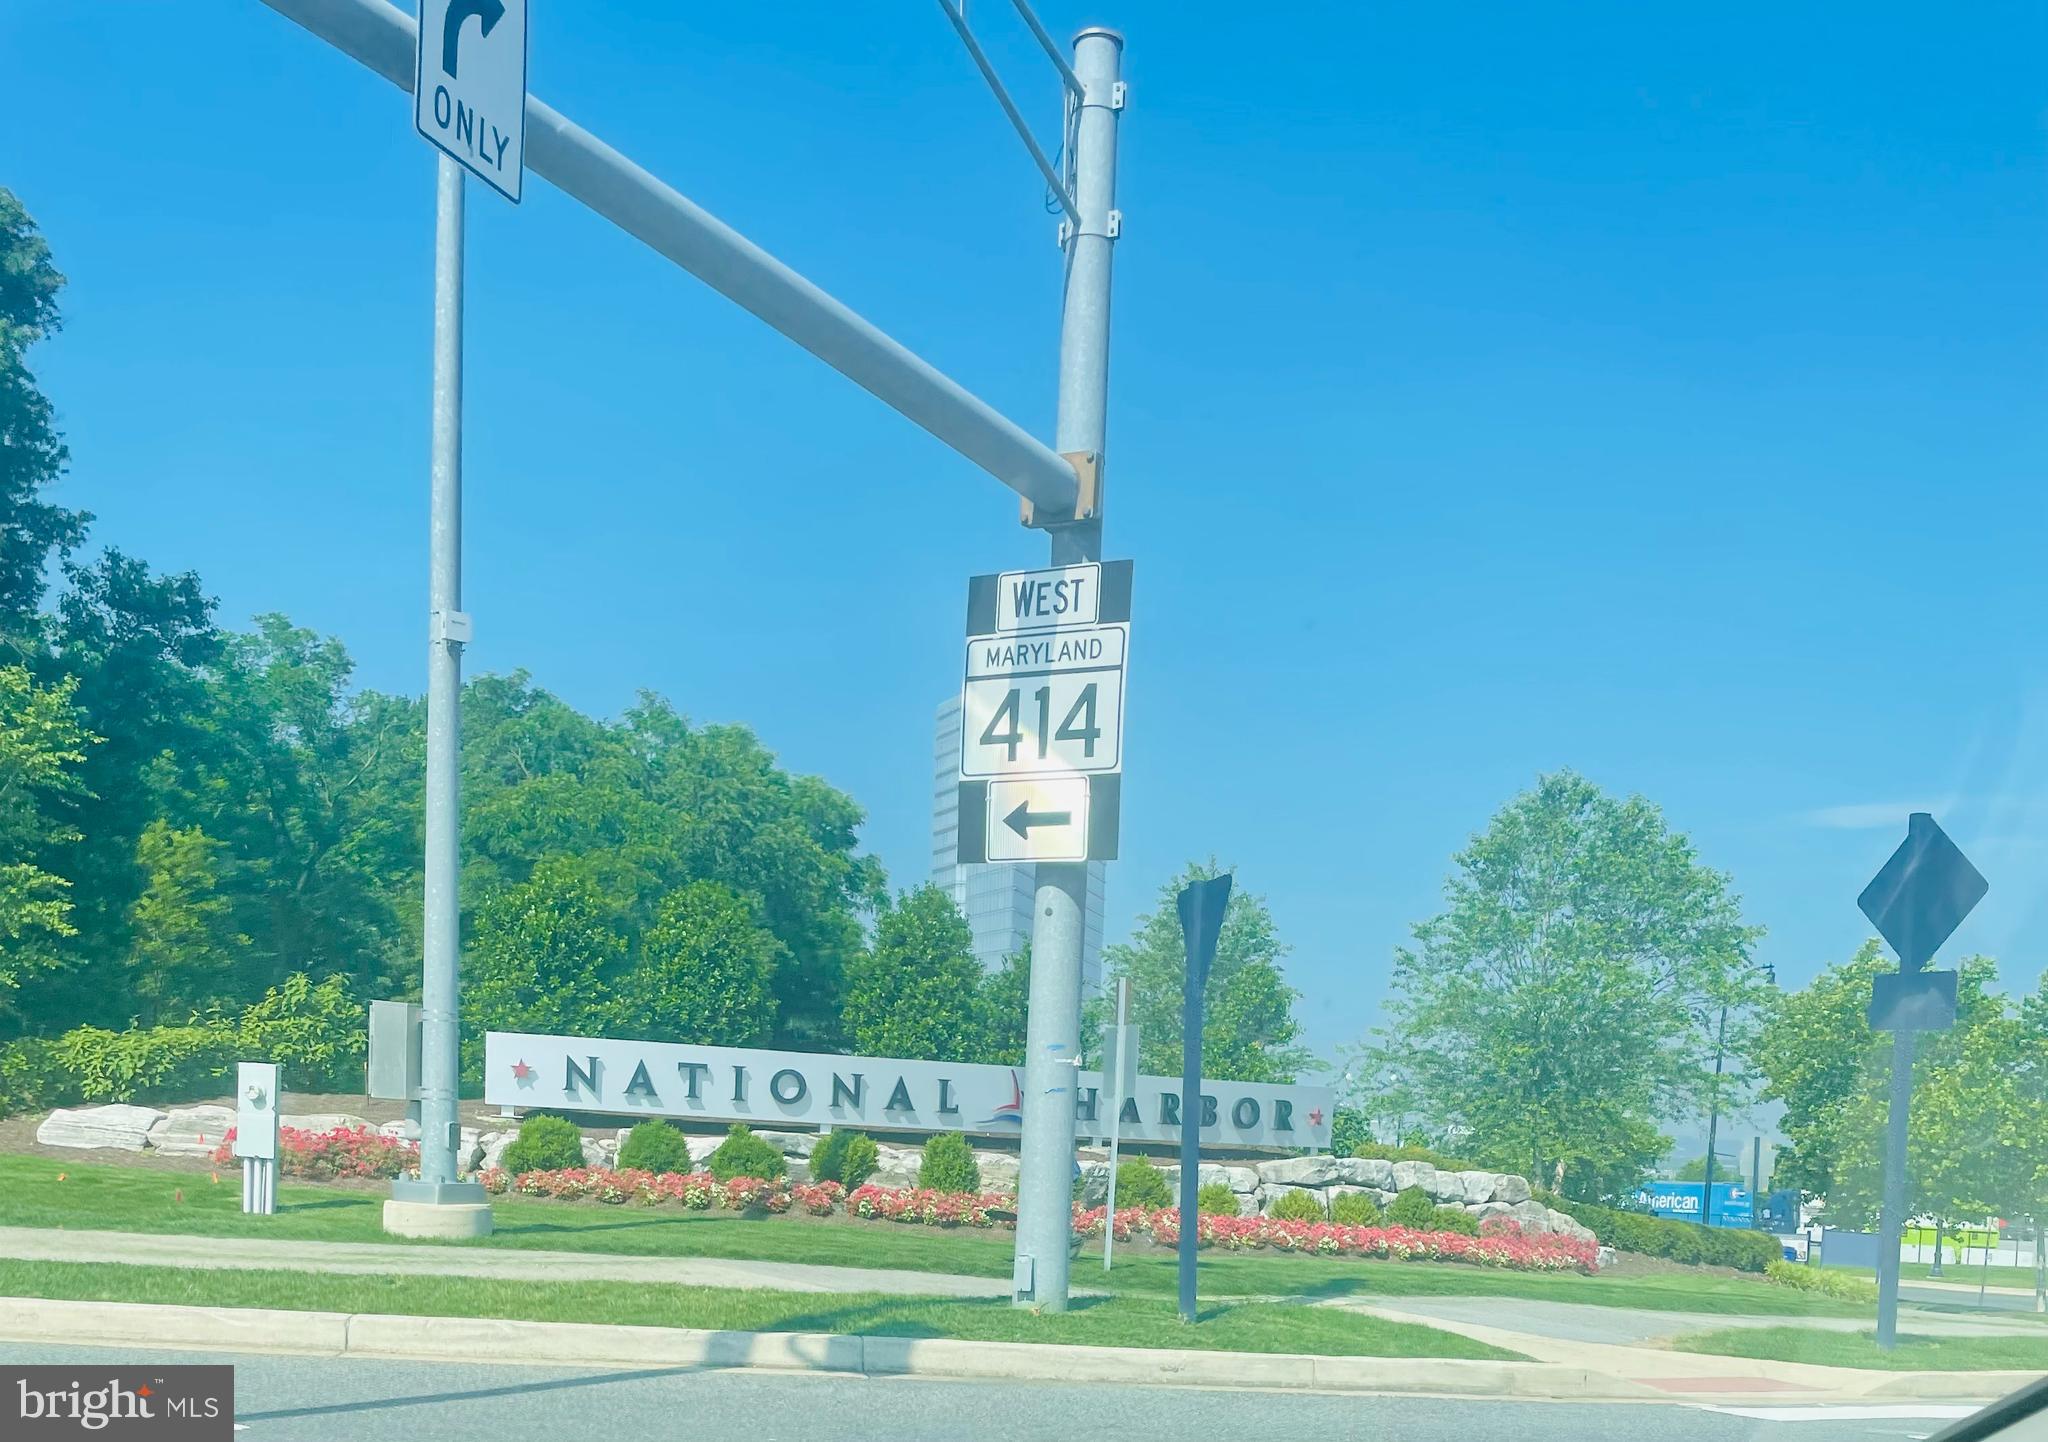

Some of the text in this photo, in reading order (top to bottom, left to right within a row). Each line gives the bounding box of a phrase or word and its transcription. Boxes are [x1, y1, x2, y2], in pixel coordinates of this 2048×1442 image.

[434, 85, 510, 171] ONLY
[1013, 578, 1085, 618] WEST
[986, 638, 1103, 668] MARYLAND
[979, 682, 1102, 762] 414
[563, 1054, 1294, 1132] NATIONAL HARBOR
